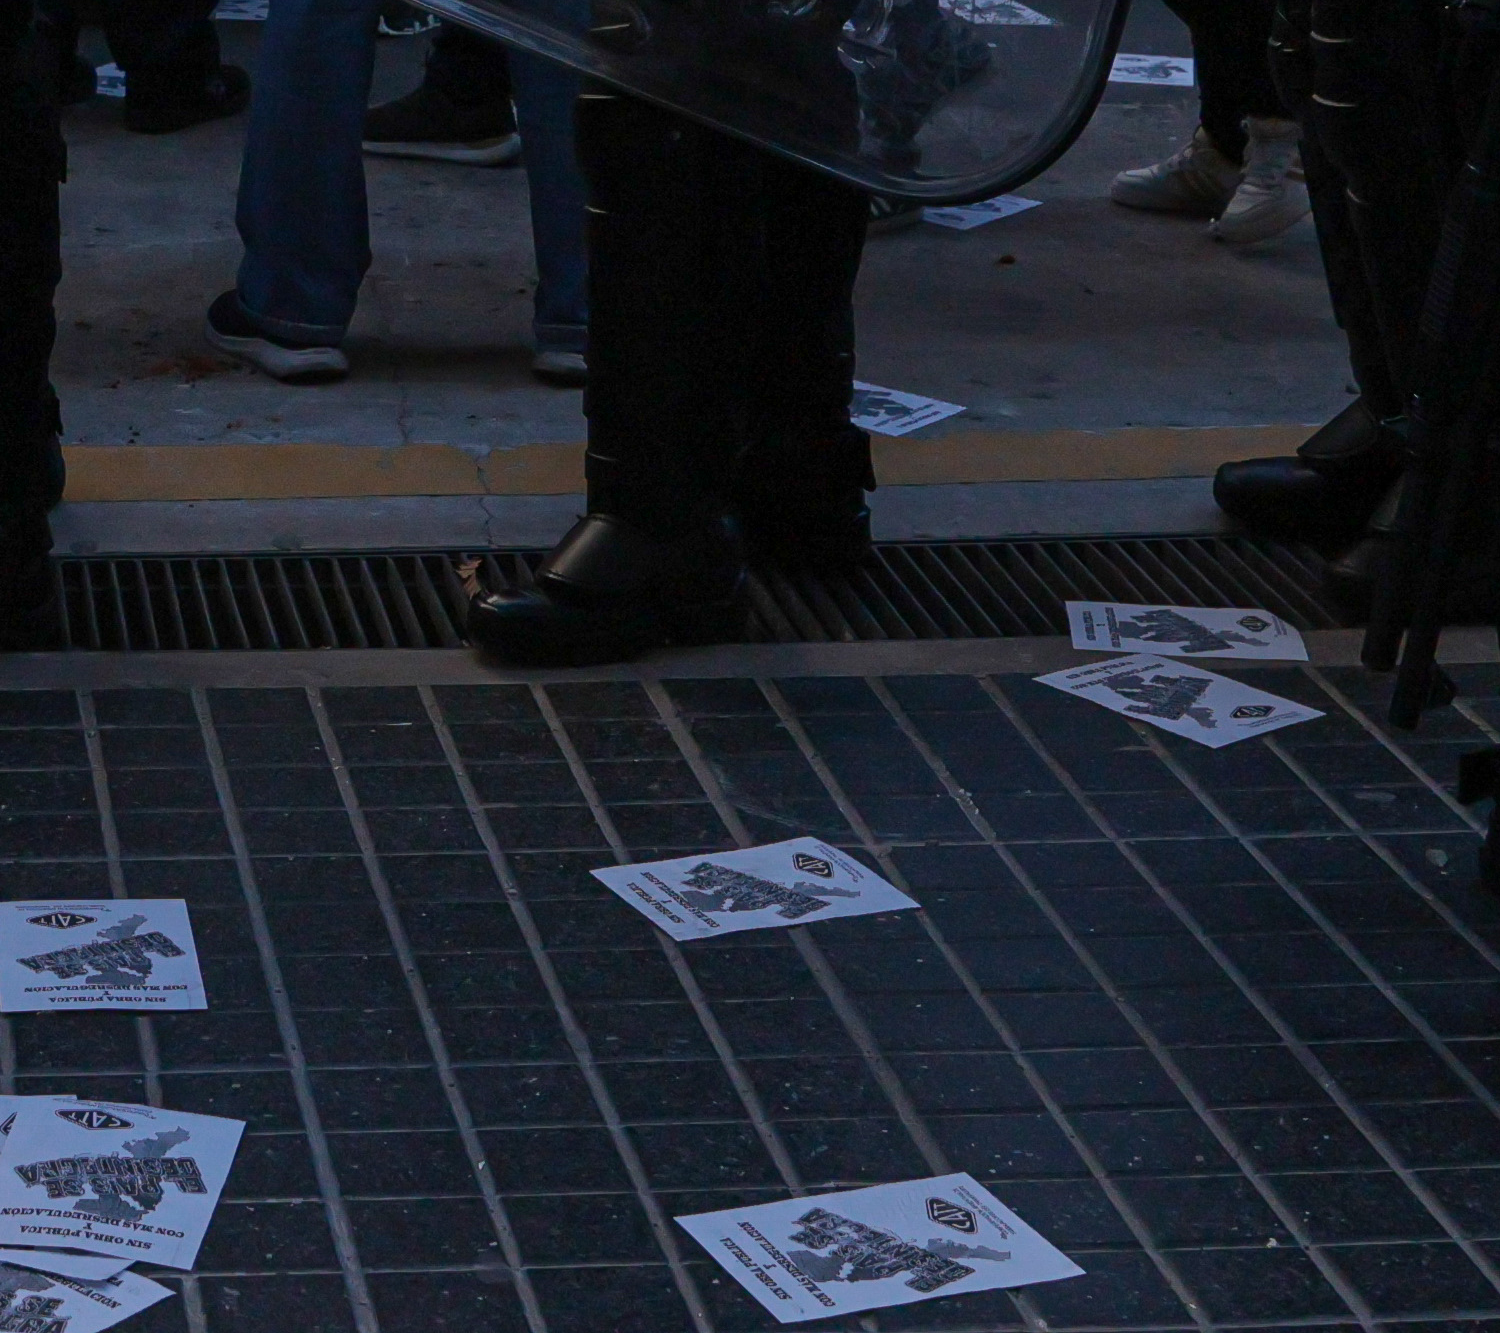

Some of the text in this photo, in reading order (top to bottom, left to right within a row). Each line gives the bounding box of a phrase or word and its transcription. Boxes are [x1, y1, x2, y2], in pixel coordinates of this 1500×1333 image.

[38, 913, 86, 928] CATT
[68, 1111, 120, 1129] CATT
[925, 1199, 977, 1231] CATT
[20, 1225, 152, 1249] SIN OBRA PÚBLICA
[155, 1228, 184, 1239] CON
[747, 1266, 778, 1286] OBRA
[767, 1285, 792, 1300] SIN
[809, 1291, 837, 1307] CON
